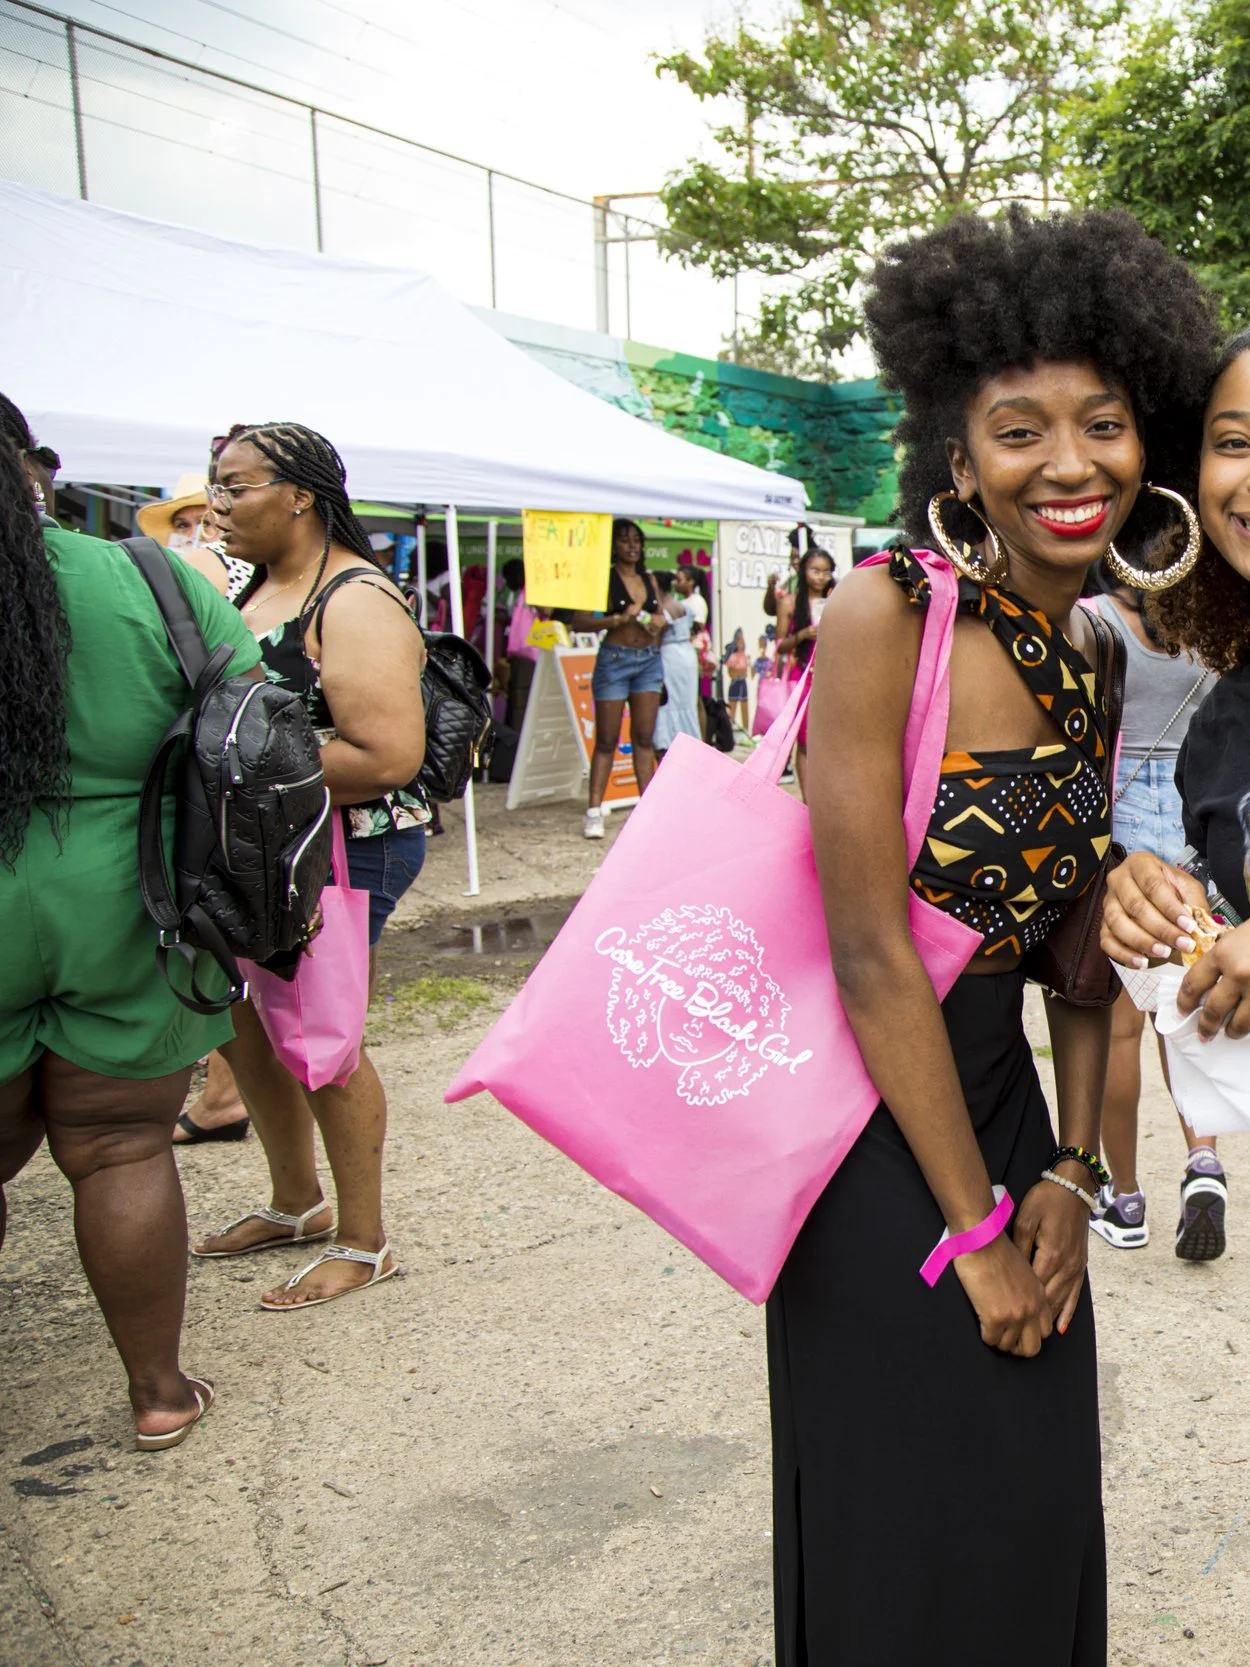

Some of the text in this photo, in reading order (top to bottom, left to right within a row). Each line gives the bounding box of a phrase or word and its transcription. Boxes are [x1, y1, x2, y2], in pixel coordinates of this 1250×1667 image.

[645, 546, 669, 558] OVE
[594, 927, 645, 975] Care
[684, 981, 758, 1051] Black
[759, 1034, 813, 1074] Girl
